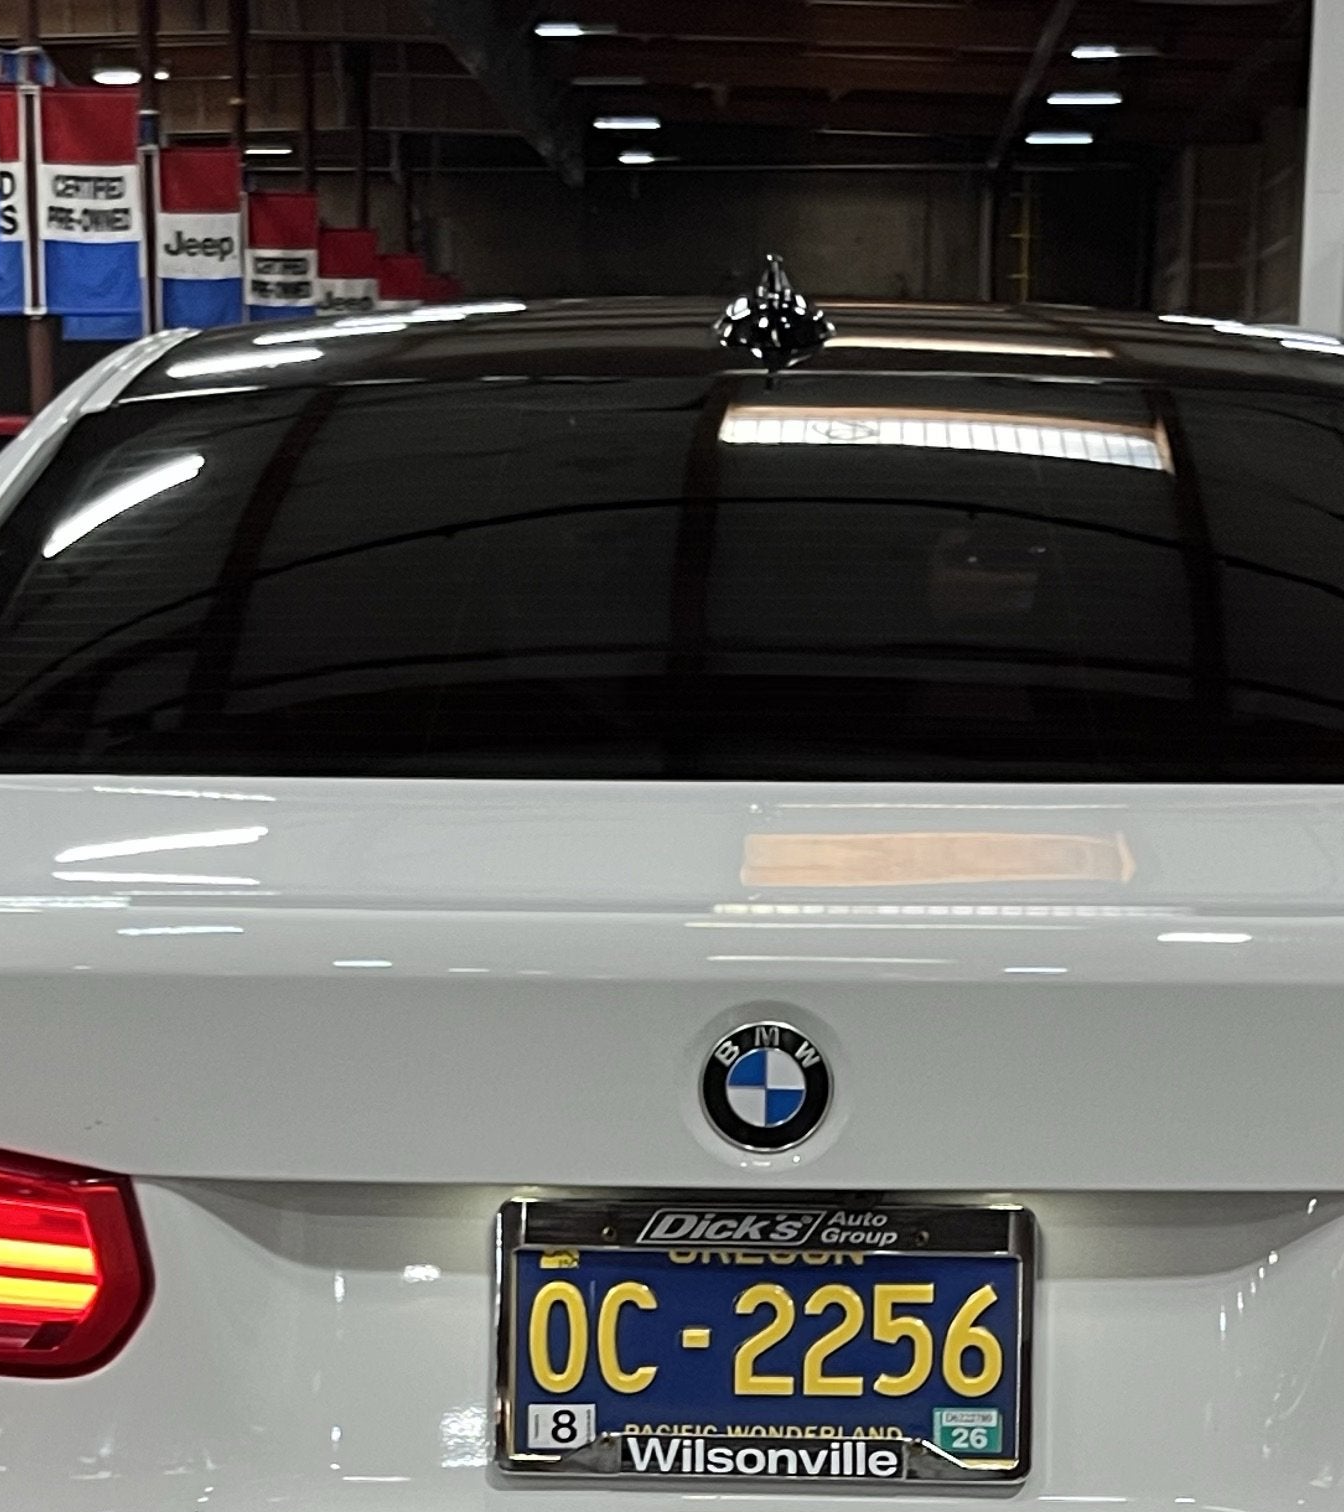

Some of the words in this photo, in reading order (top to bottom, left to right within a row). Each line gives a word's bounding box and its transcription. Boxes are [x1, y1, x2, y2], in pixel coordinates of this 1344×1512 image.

[164, 231, 234, 262] Jeep
[714, 1026, 821, 1069] BMW
[650, 1212, 803, 1241] Dick's
[827, 1210, 888, 1228] Auto
[820, 1227, 898, 1247] Group
[551, 1409, 578, 1443] 8
[951, 1427, 989, 1450] 26
[626, 1437, 898, 1477] Wilsonville
